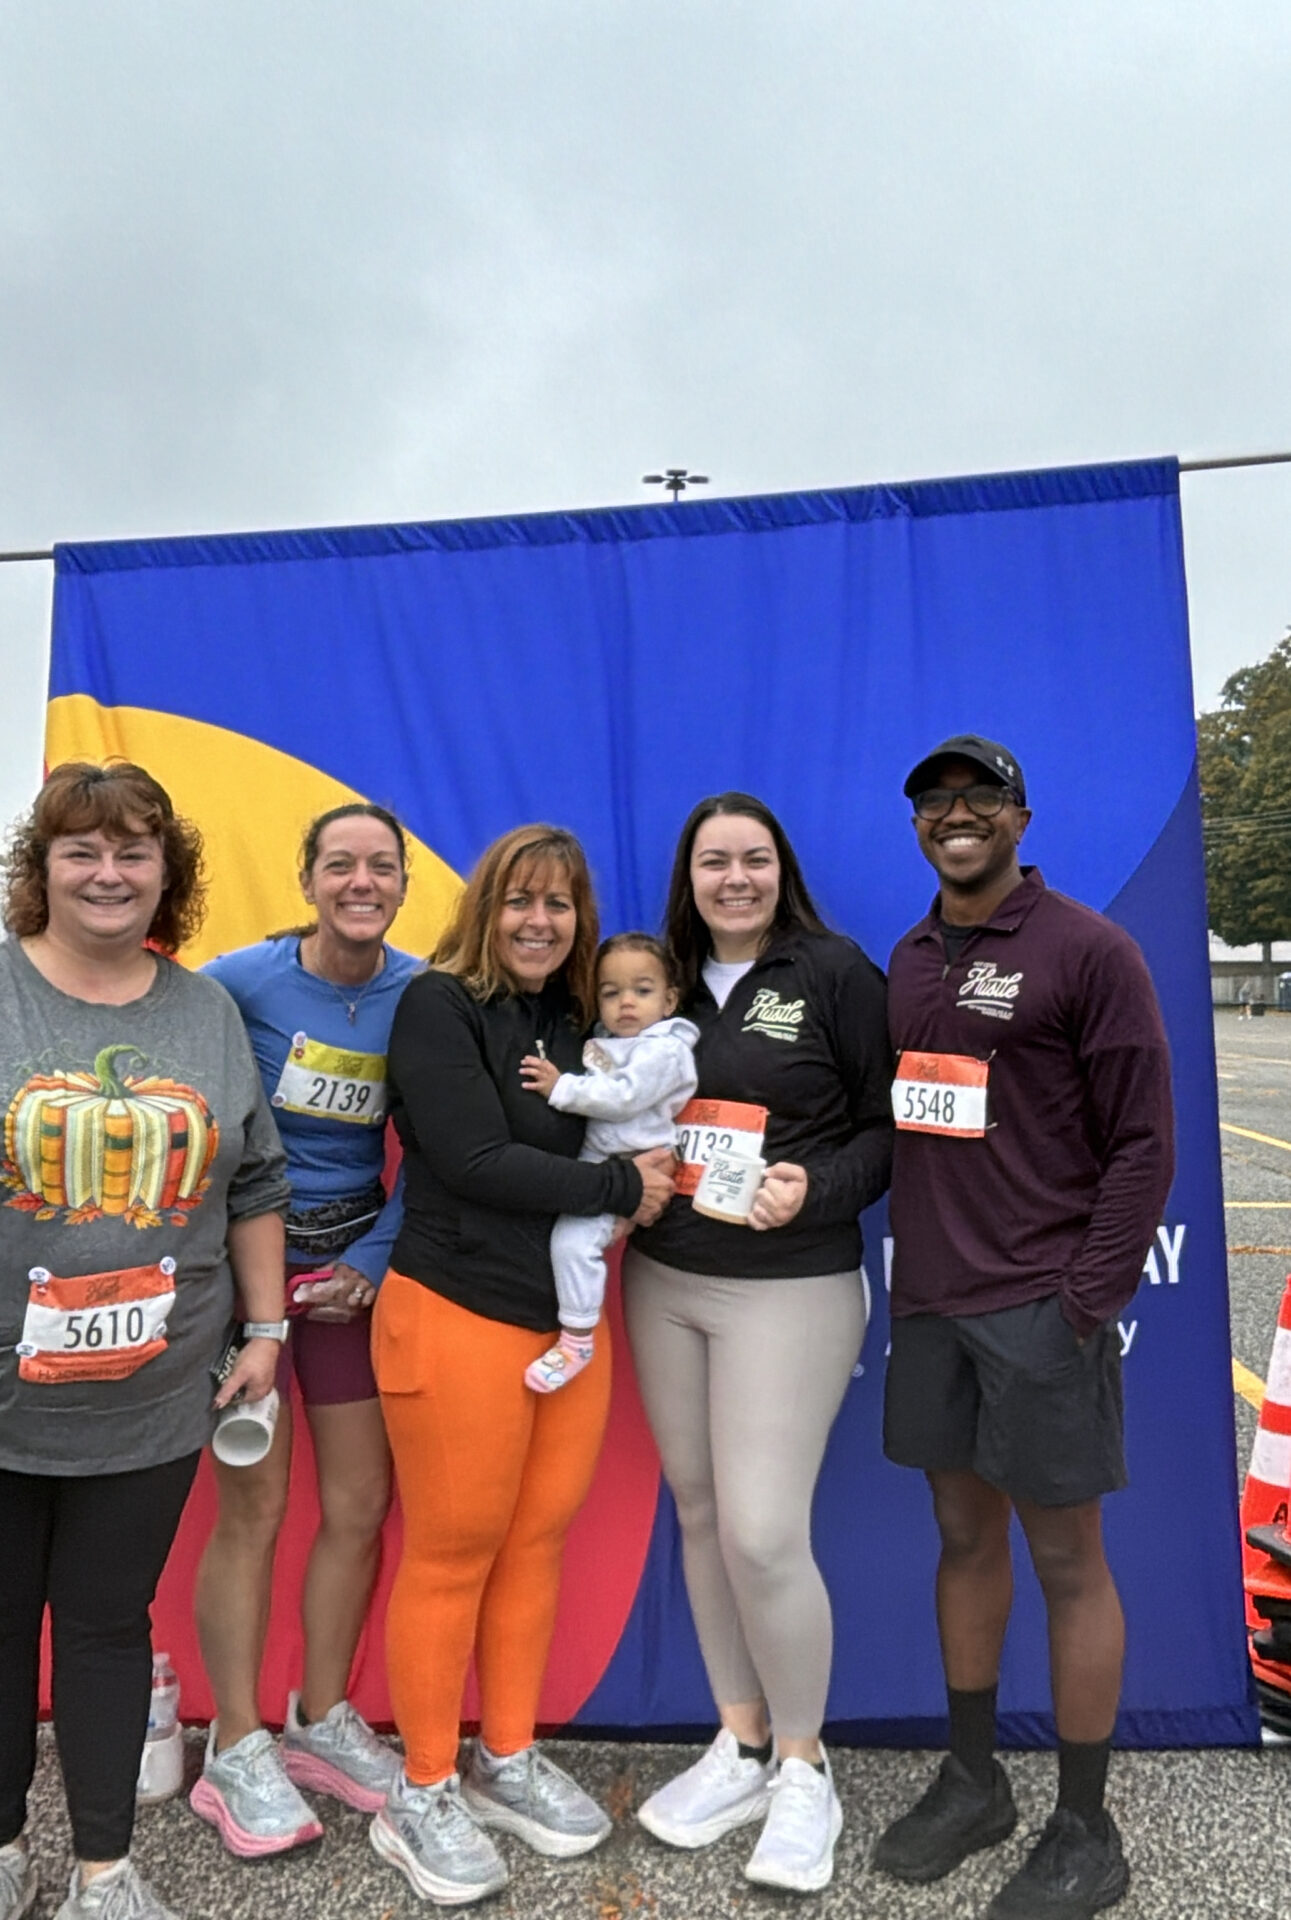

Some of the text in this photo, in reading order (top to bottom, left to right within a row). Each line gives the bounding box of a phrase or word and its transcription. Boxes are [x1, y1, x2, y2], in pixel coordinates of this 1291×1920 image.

[959, 967, 1023, 999] Hustle
[744, 993, 805, 1024] Hustle
[306, 1077, 371, 1113] 2139
[903, 1086, 955, 1124] 5548
[64, 1306, 144, 1349] 5610
